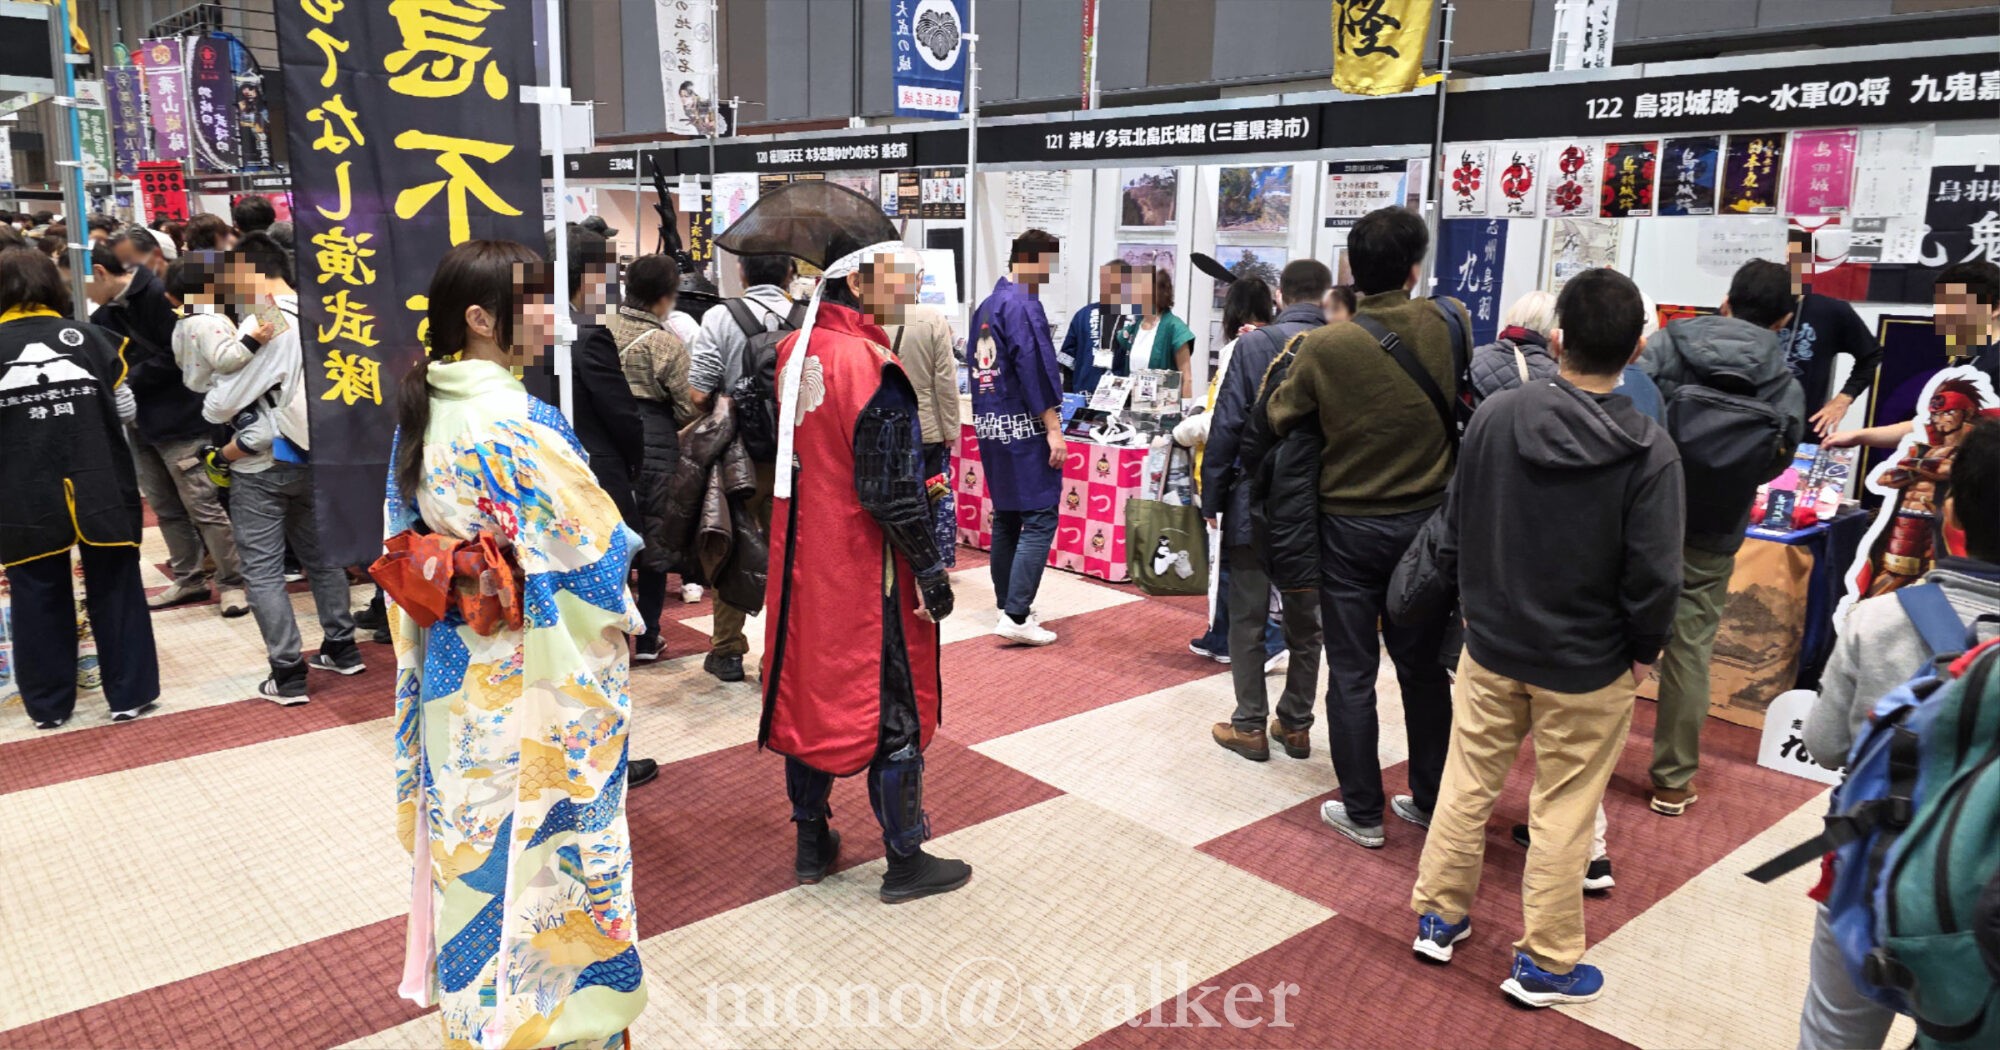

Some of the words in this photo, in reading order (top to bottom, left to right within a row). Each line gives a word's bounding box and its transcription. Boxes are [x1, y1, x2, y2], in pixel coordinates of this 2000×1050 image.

[1586, 97, 1622, 119] 122
[1045, 134, 1063, 149] 121
[881, 142, 908, 159] 桑名市
